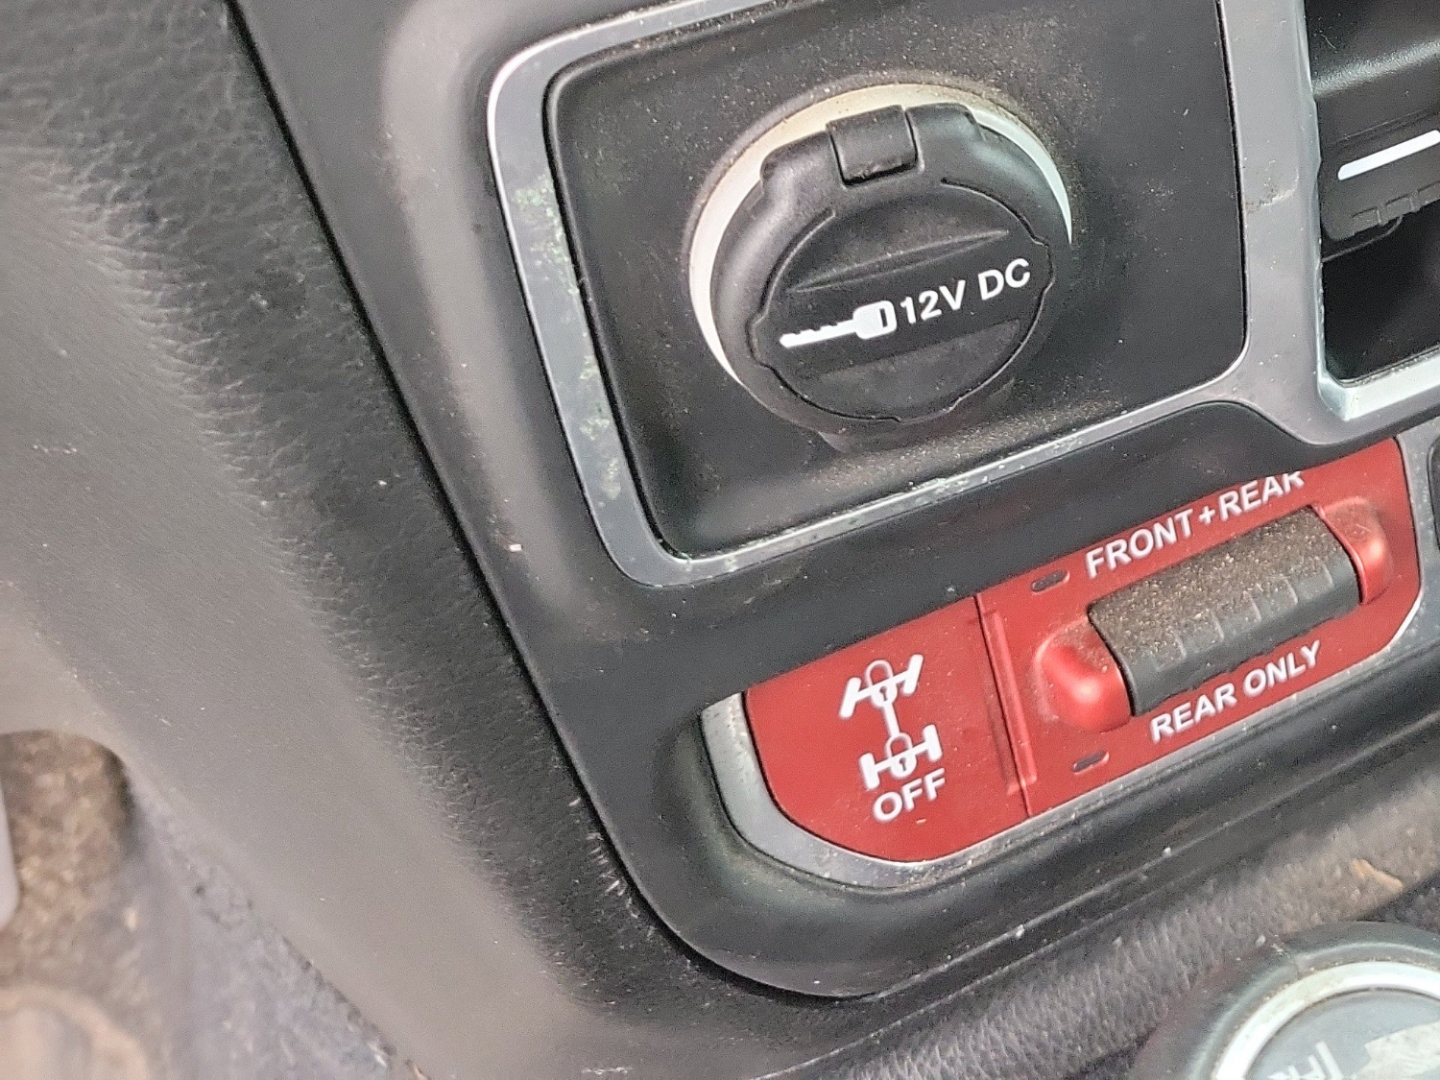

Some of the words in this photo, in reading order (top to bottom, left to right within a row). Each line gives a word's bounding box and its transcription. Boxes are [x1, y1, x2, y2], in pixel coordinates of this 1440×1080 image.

[899, 279, 966, 324] 12V
[977, 258, 1031, 301] DC
[1149, 682, 1238, 744] REAR
[1243, 639, 1321, 698] ONLY
[872, 767, 946, 823] OFF
